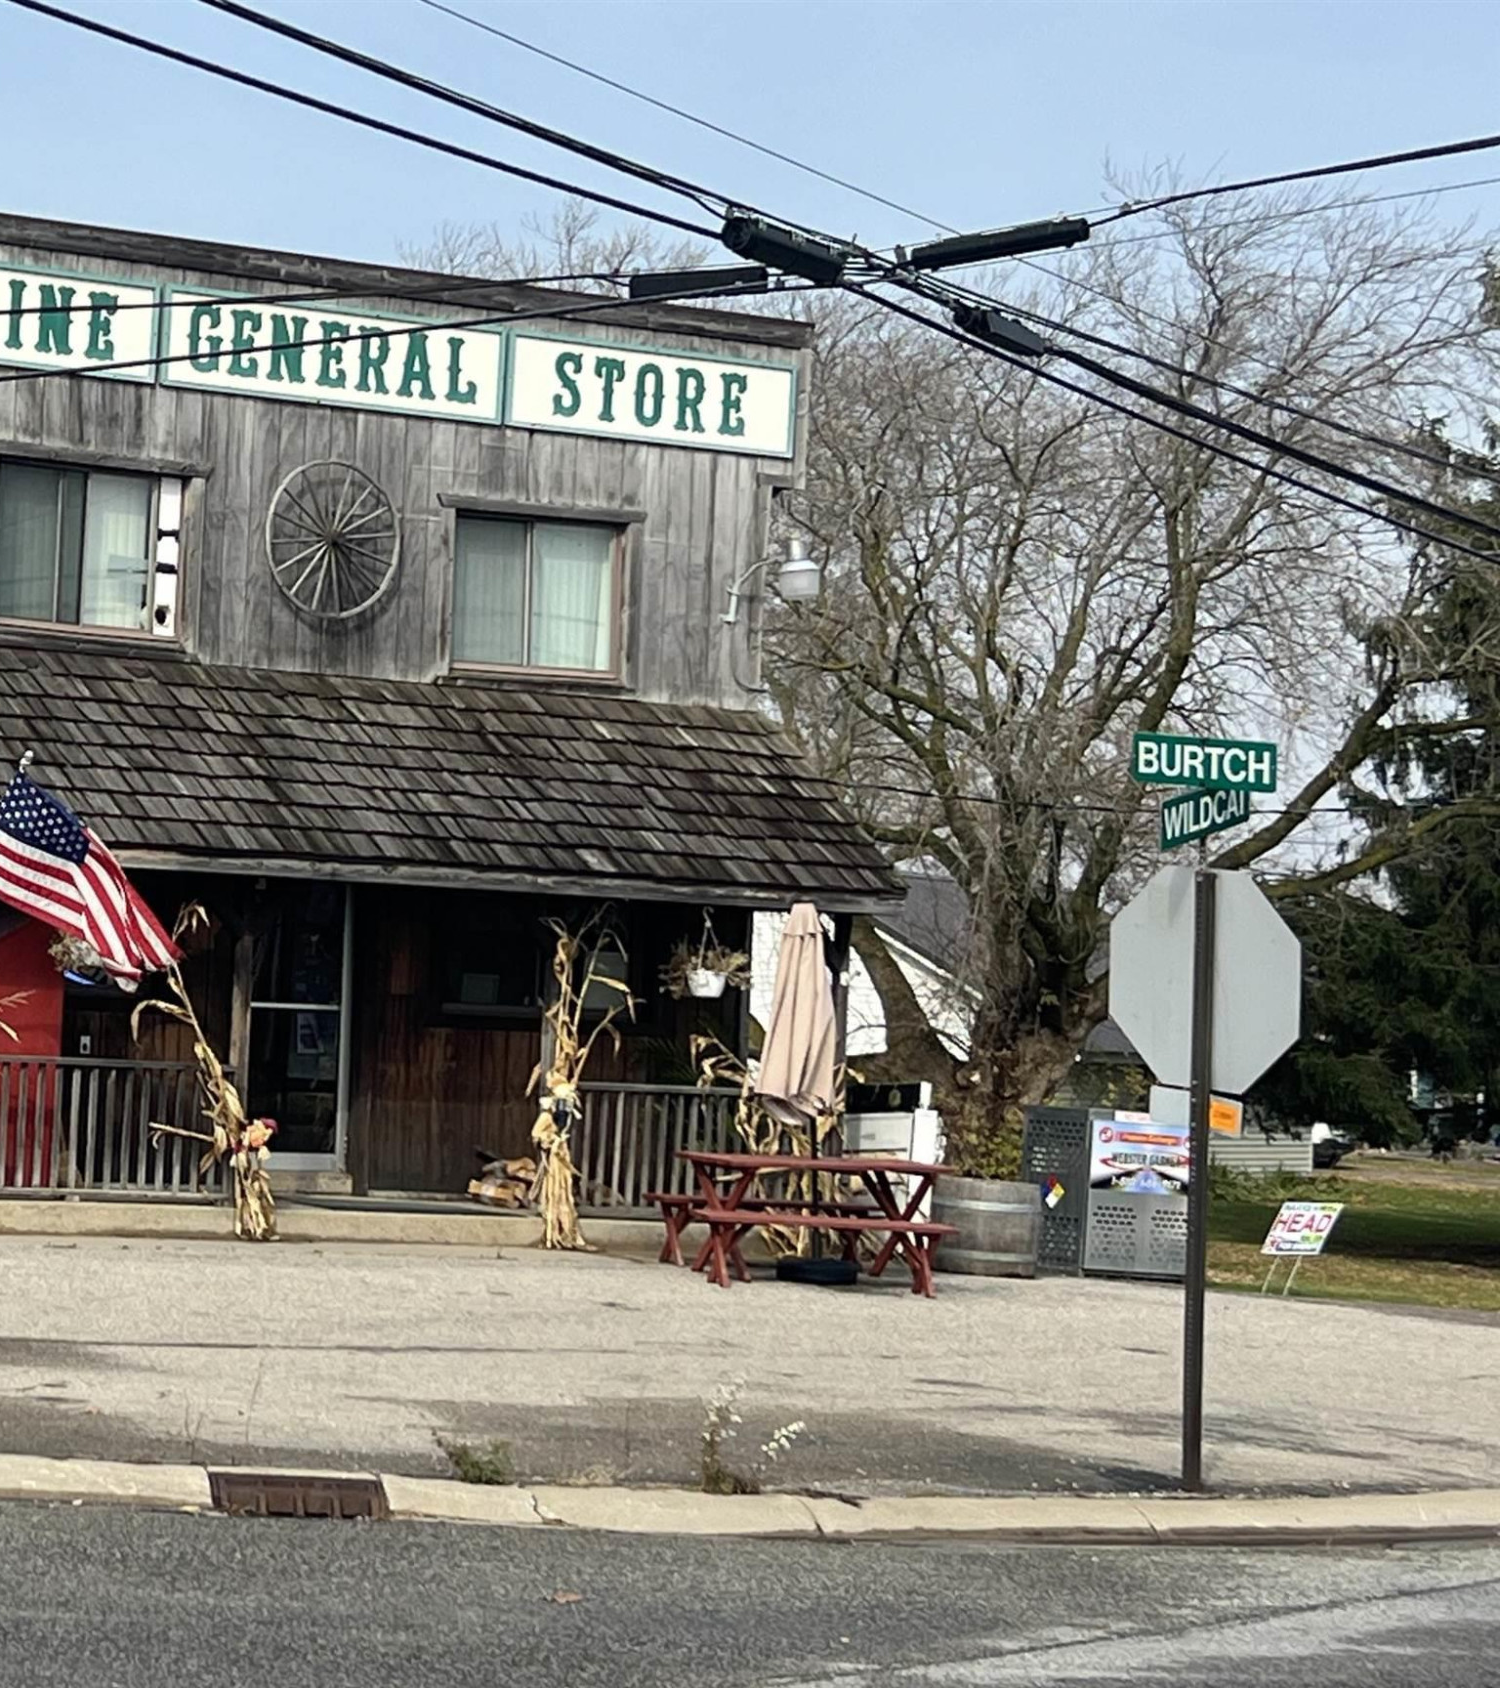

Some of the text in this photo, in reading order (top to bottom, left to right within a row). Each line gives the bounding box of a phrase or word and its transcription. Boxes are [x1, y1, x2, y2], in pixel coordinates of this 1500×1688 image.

[187, 303, 478, 405] GENERAL
[552, 351, 748, 437] STORE
[1137, 741, 1271, 785] BURTCH
[1273, 1213, 1332, 1233] HEAD
